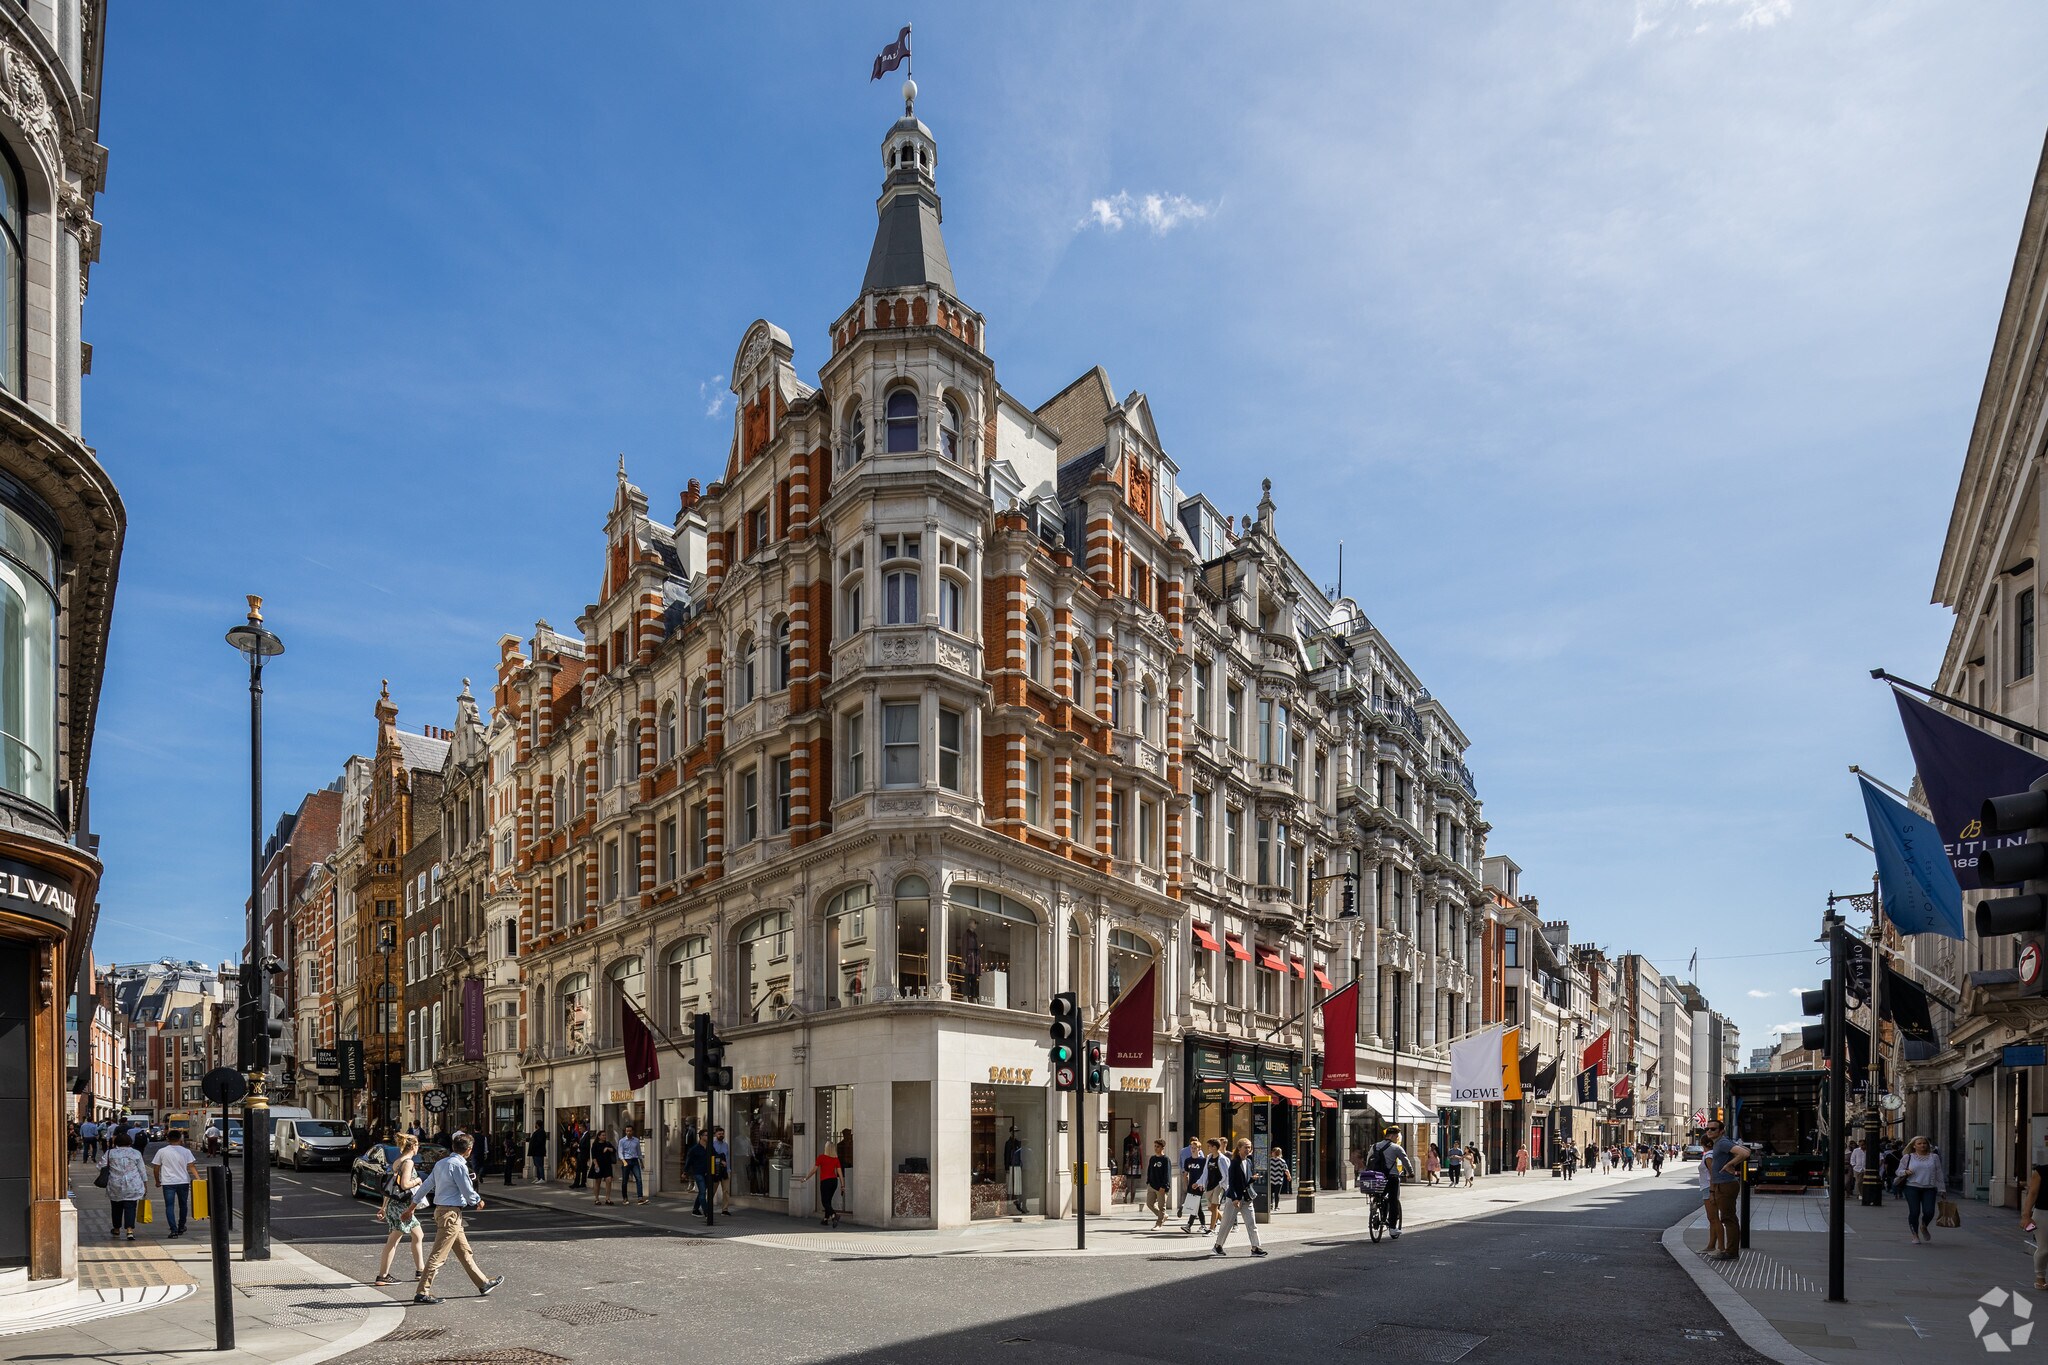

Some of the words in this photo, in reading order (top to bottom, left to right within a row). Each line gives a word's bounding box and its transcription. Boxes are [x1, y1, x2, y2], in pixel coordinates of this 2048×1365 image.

[1943, 836, 2028, 856] EITLIN
[1953, 858, 1979, 868] 188
[1902, 825, 1935, 926] SMYON
[1853, 944, 1864, 977] OPERA
[875, 985, 944, 1001] BALLY
[980, 995, 996, 1003] BALL
[347, 1046, 356, 1080] BROWNS
[1265, 1061, 1289, 1072] WEMPE
[741, 1072, 777, 1090] BALLY
[989, 1066, 1034, 1085] BALLY
[1120, 1076, 1153, 1091] BALLY
[1456, 1088, 1499, 1099] LOEWE
